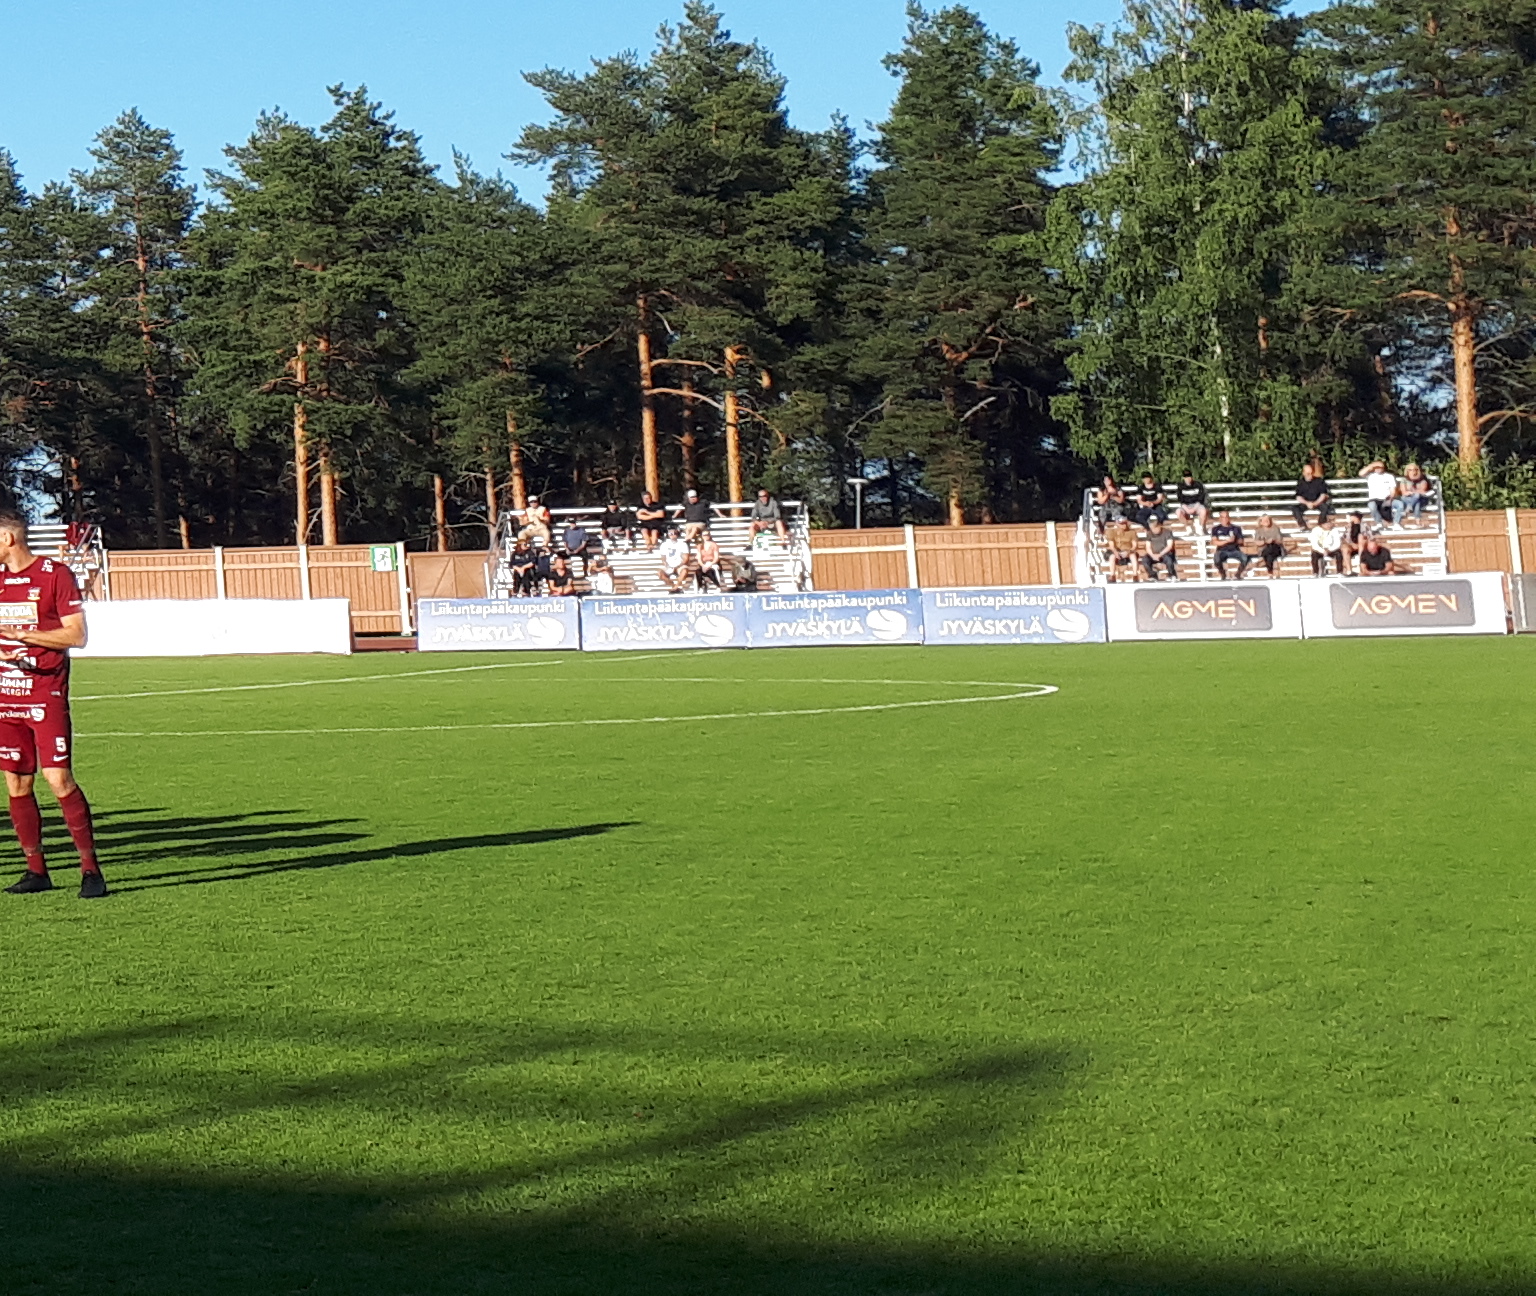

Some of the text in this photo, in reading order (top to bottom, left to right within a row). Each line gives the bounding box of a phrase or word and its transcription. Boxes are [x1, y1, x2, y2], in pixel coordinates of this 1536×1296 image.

[431, 600, 565, 618] Liikuntapääkaupunki
[594, 597, 734, 617] Liikuntapääkaupunki
[762, 592, 907, 612] Liikuntapääkaupunki
[936, 590, 1089, 610] Liikuntapääkaupunki
[1152, 599, 1256, 619] AGMEN
[1349, 593, 1459, 616] AGMEN
[596, 621, 693, 642] JYVÄSKYLÄ
[764, 617, 864, 638] JYVÄSKYLÄ
[939, 615, 1043, 635] JYVÄSKYLÄ
[55, 737, 67, 752] 5
